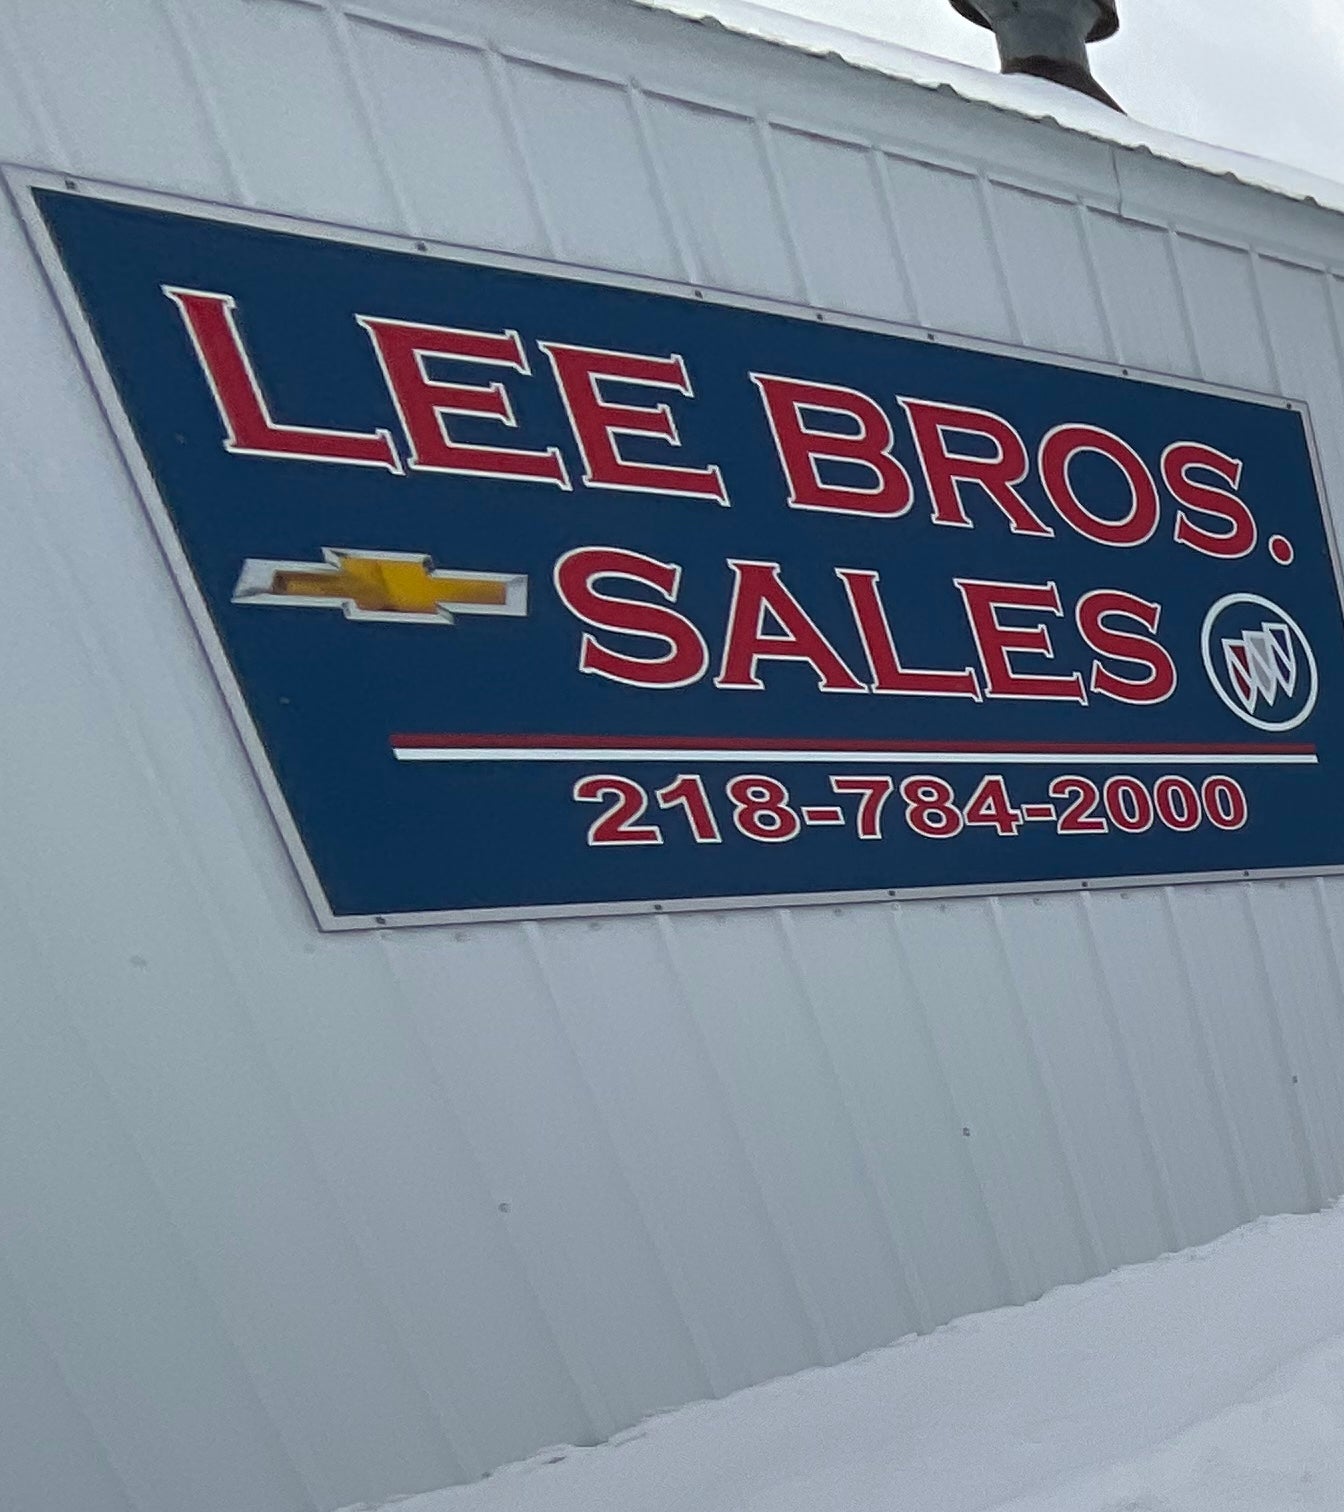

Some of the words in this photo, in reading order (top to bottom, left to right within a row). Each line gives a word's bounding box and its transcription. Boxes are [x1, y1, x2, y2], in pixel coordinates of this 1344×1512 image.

[162, 285, 731, 507] LEE
[749, 371, 1294, 565] BROS.
[553, 546, 1178, 706] SALES
[573, 773, 1249, 846] 218-784-2000
